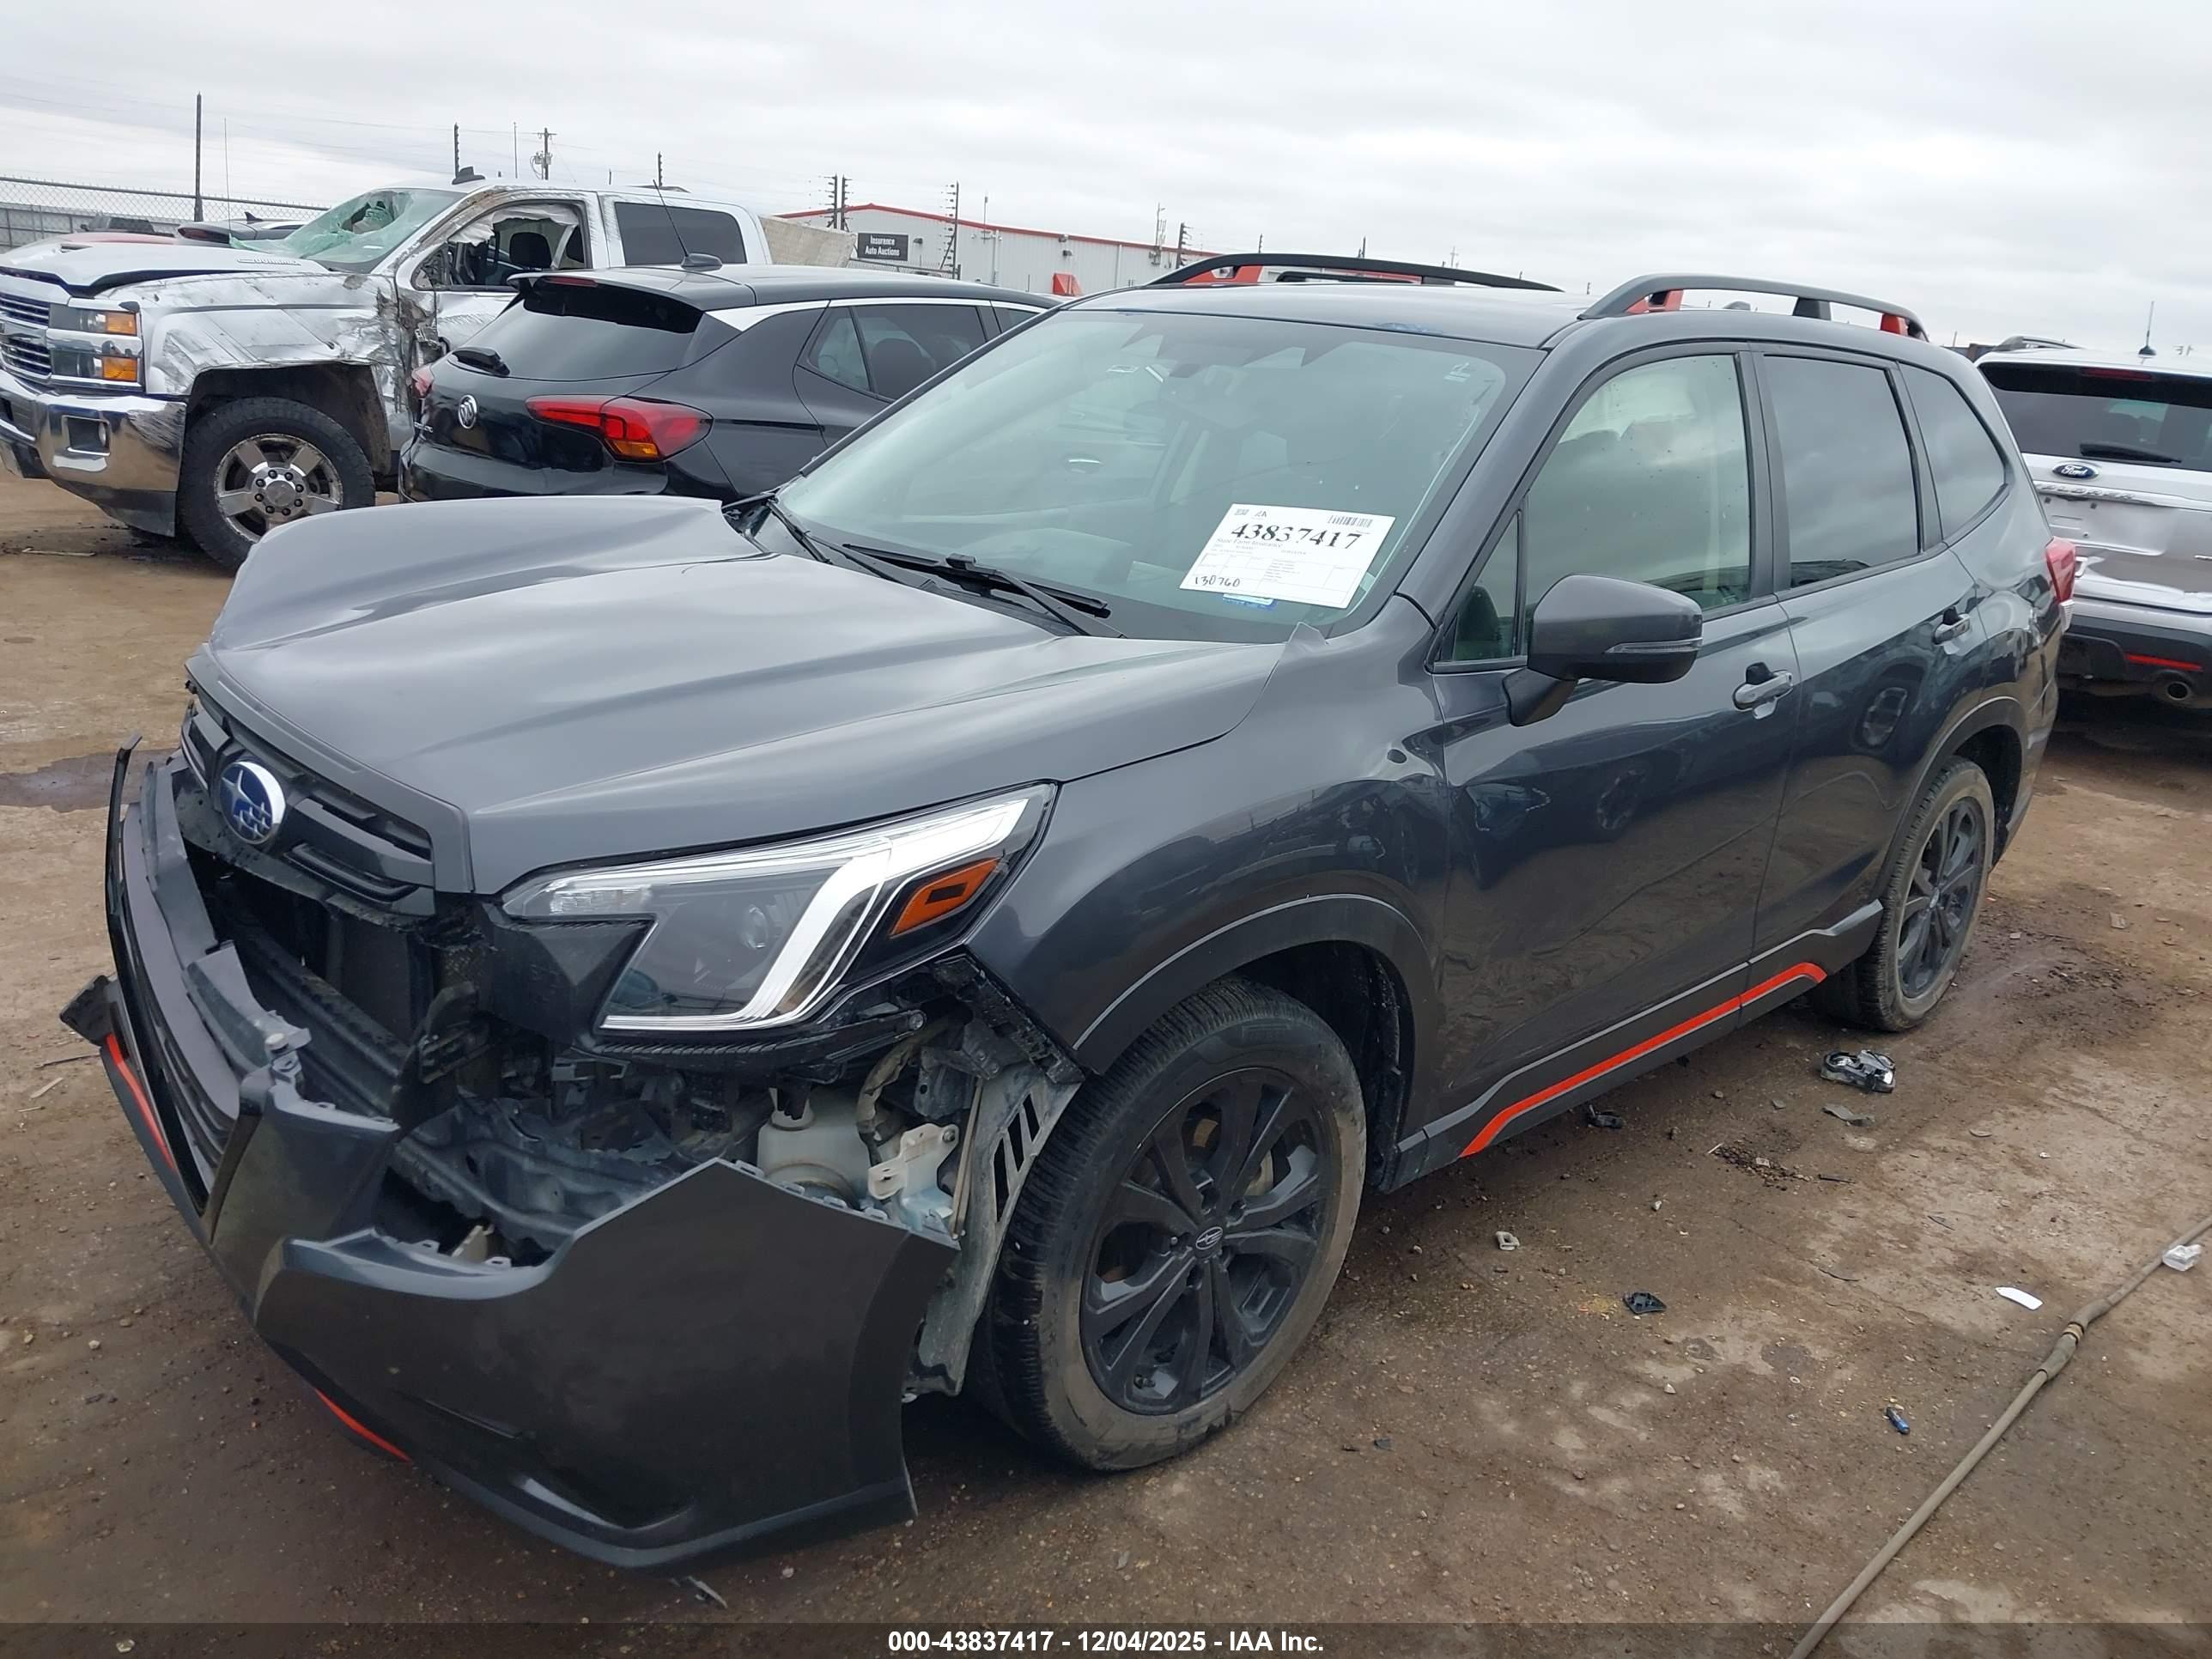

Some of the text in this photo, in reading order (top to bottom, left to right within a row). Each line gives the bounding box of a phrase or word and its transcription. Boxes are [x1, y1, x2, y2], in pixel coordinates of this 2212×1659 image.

[870, 235, 896, 246] Insurance
[865, 246, 900, 256] Auto Auctions
[2060, 464, 2089, 477] Ford
[1231, 522, 1363, 550] 43837417
